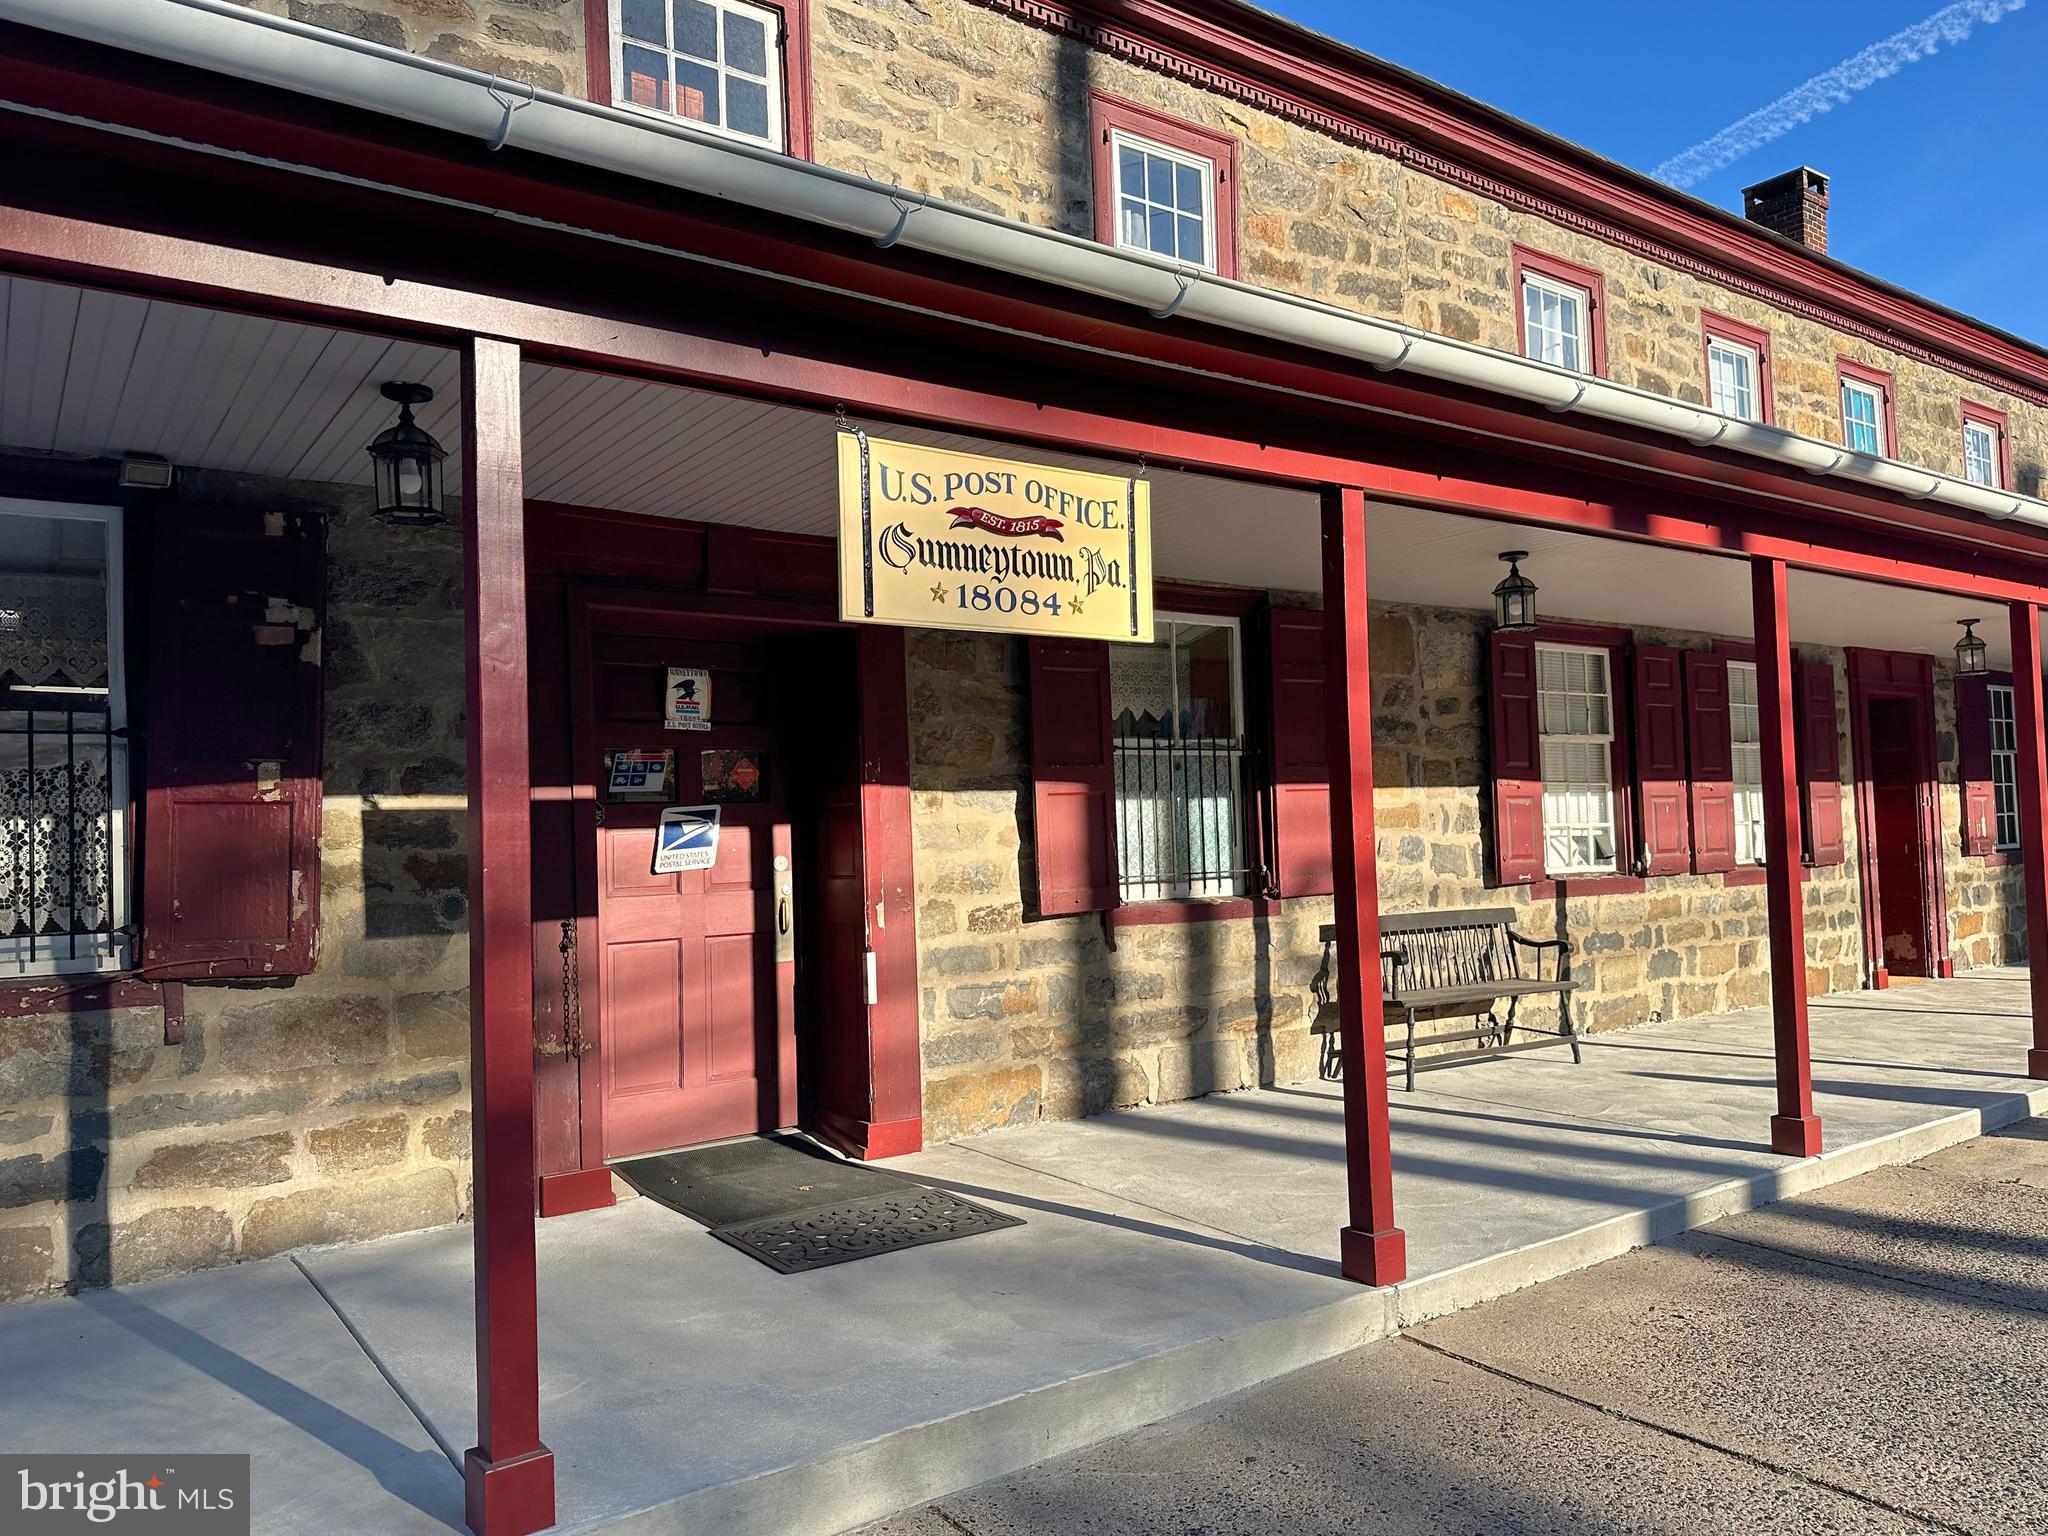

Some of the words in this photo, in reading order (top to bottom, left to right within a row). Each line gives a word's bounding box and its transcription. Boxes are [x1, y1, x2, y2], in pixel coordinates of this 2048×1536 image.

[879, 463, 937, 505] U.S.
[943, 472, 1017, 501] POST
[1024, 480, 1124, 530] OFFICE.
[979, 512, 1006, 530] EST.
[1009, 519, 1041, 533] 1815
[1079, 546, 1127, 598] Pa.
[956, 584, 1061, 616] 18084
[660, 853, 685, 861] UNITED
[685, 851, 709, 859] STATES
[684, 857, 711, 866] SERVICE
